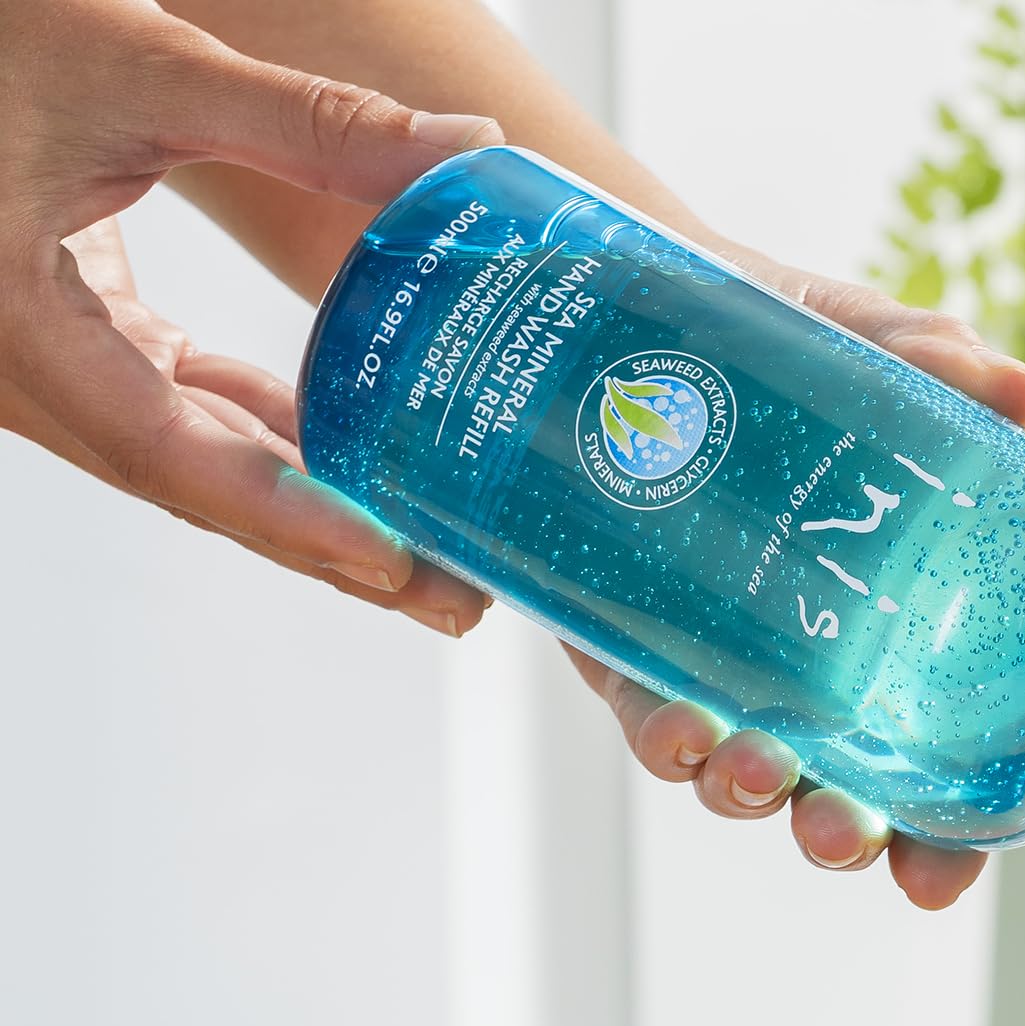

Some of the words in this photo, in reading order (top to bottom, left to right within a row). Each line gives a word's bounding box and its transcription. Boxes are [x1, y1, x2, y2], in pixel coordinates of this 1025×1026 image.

[429, 200, 488, 256] 500ml
[493, 233, 526, 264] AUX
[435, 262, 500, 347] MINÉRAUX
[461, 257, 529, 336] RECHARGE
[519, 283, 543, 306] with
[539, 256, 602, 313] HAND
[488, 303, 524, 355] seaweed
[552, 291, 596, 328] SEA
[422, 346, 444, 372] DE
[430, 336, 469, 399] SAVON
[490, 315, 549, 385] WASH
[631, 357, 704, 380] SEAWEED
[406, 372, 431, 410] MER
[464, 352, 492, 399] extracts
[492, 331, 564, 434] MINERAL
[458, 386, 502, 459] REFILL
[700, 376, 727, 446] EXTRACTS
[584, 432, 634, 498] MINERALS
[832, 431, 857, 456] the
[646, 455, 710, 501] GLYCERIN
[789, 456, 832, 510] energy
[761, 533, 782, 564] the
[775, 512, 792, 540] of
[747, 565, 765, 596] sea
